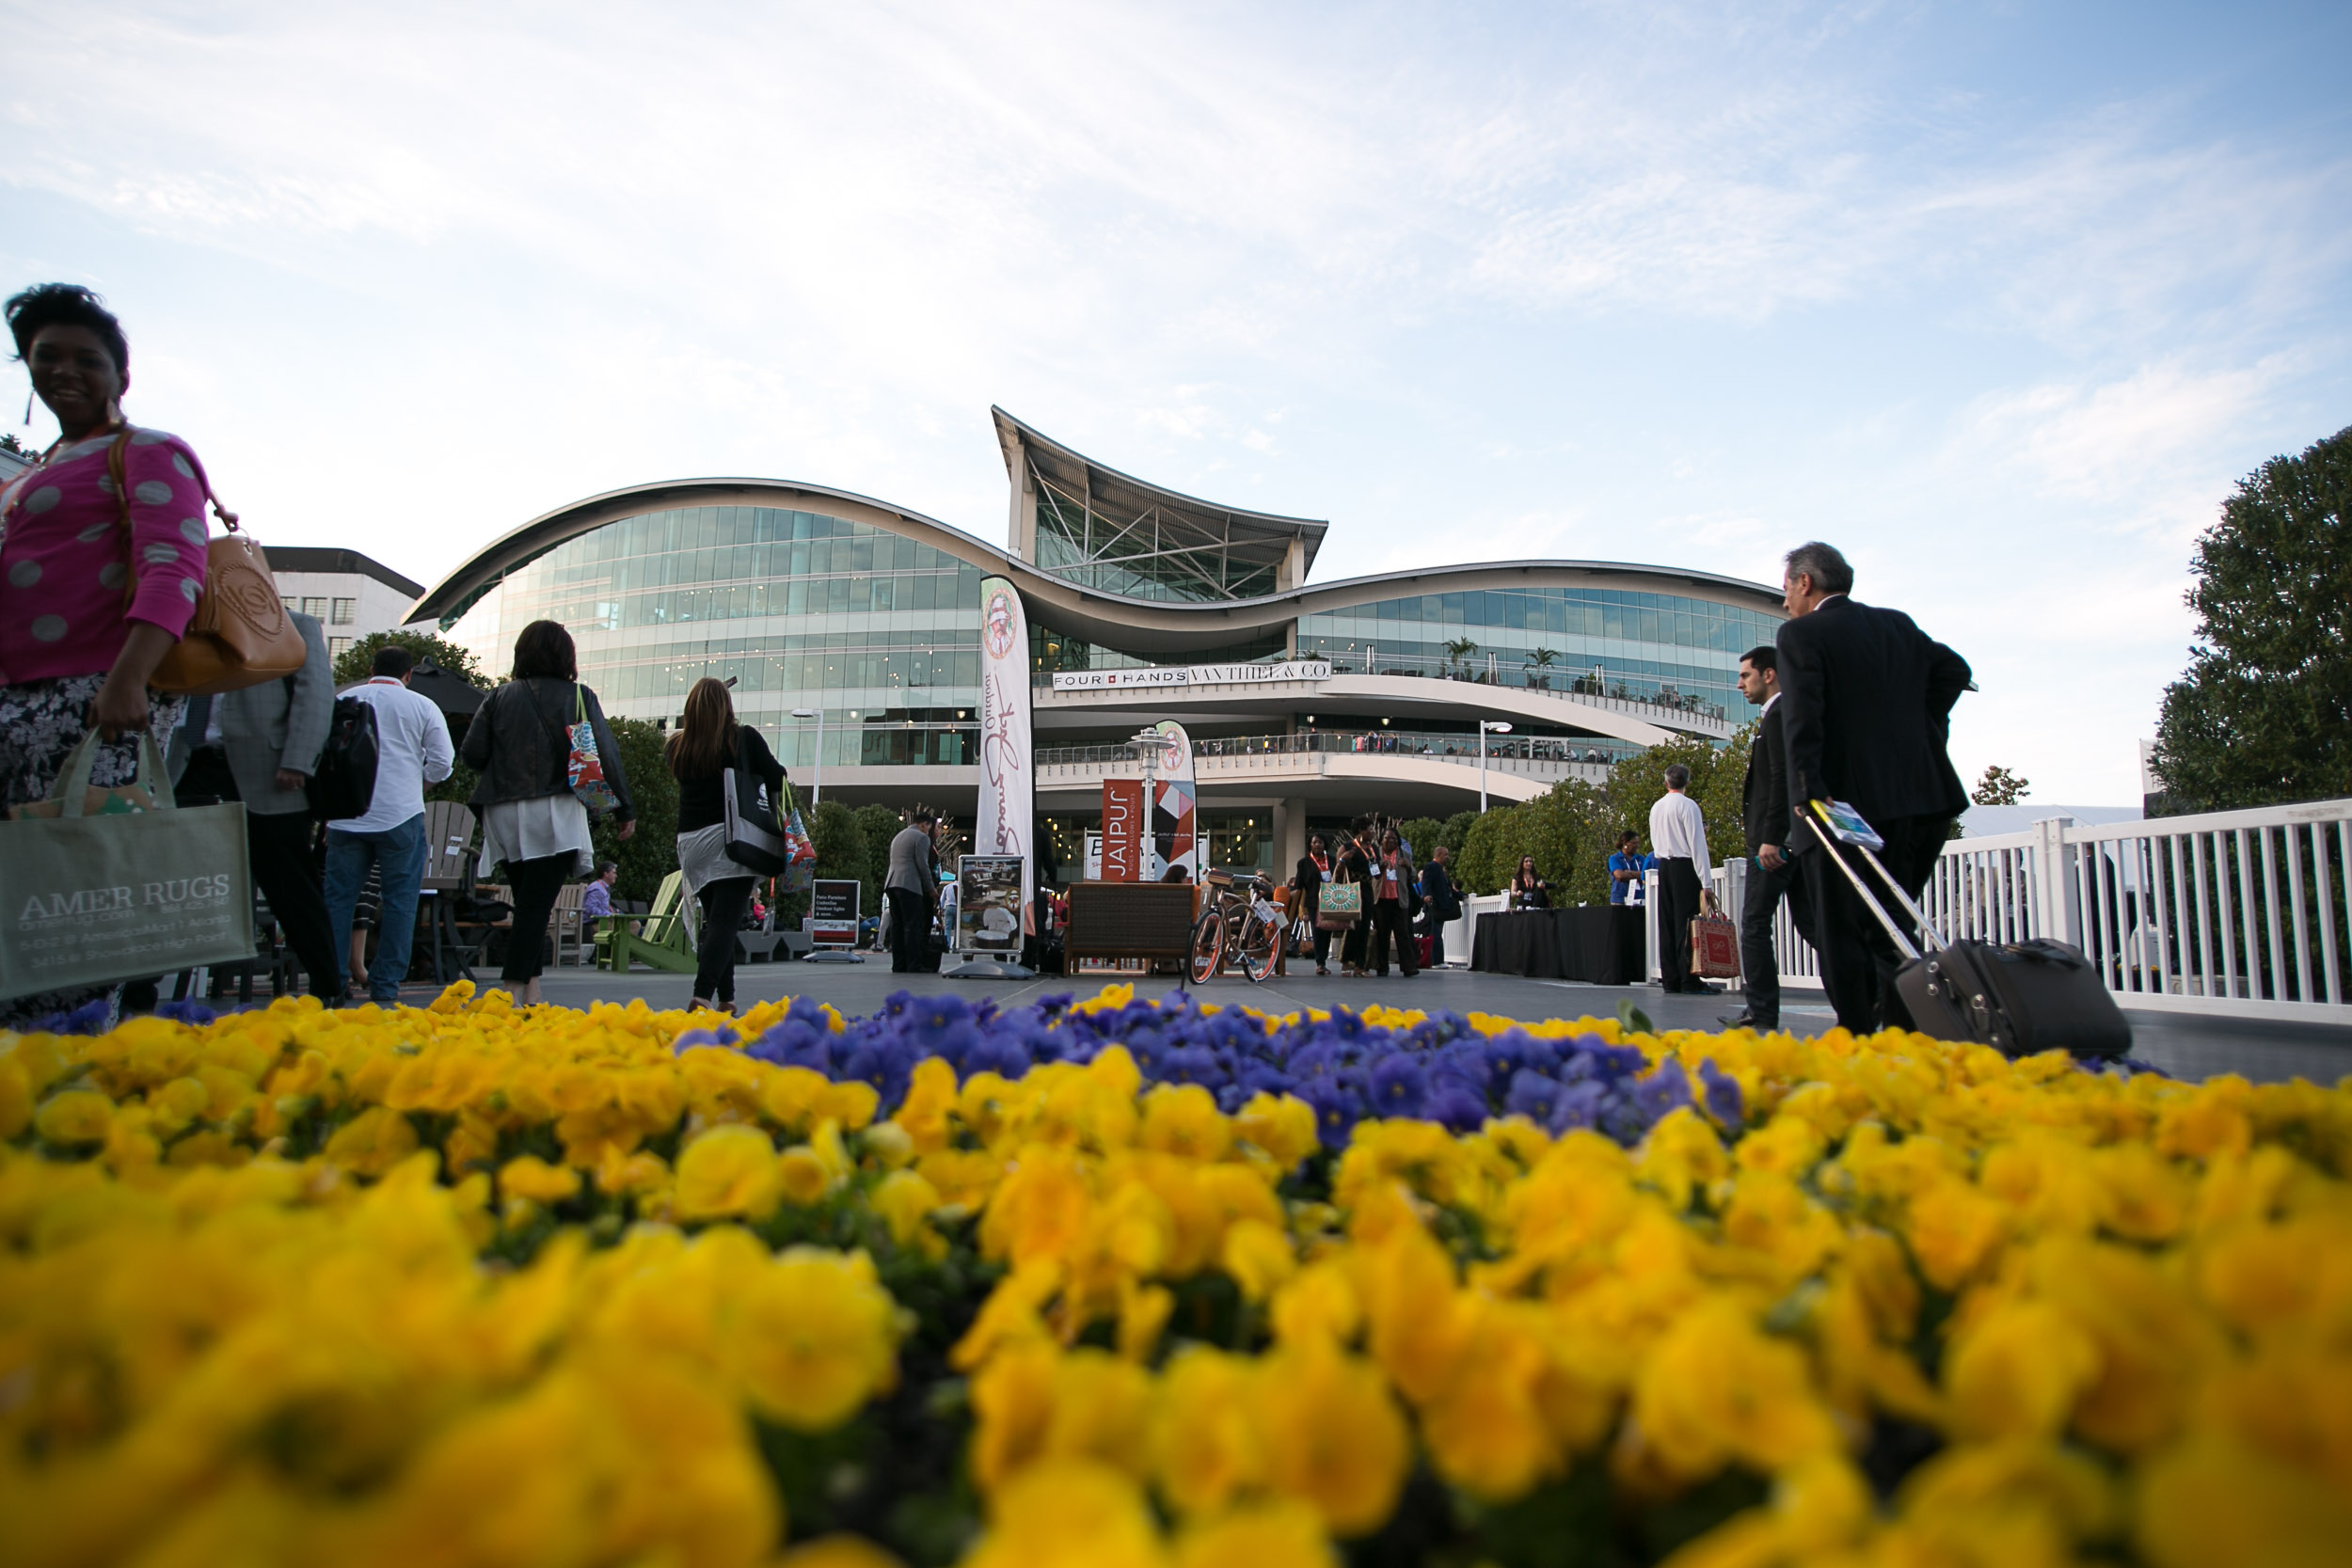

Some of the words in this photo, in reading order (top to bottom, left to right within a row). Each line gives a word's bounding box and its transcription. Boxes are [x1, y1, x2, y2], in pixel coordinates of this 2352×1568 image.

[1055, 675, 1102, 686] FOUR
[1122, 672, 1186, 683] HANDS
[1284, 664, 1295, 678] &
[1301, 663, 1330, 678] CO.
[1108, 788, 1128, 877] JAIPUR
[19, 886, 135, 921] AMER
[142, 873, 230, 906] RUGS
[163, 937, 194, 950] High
[195, 931, 227, 943] Point
